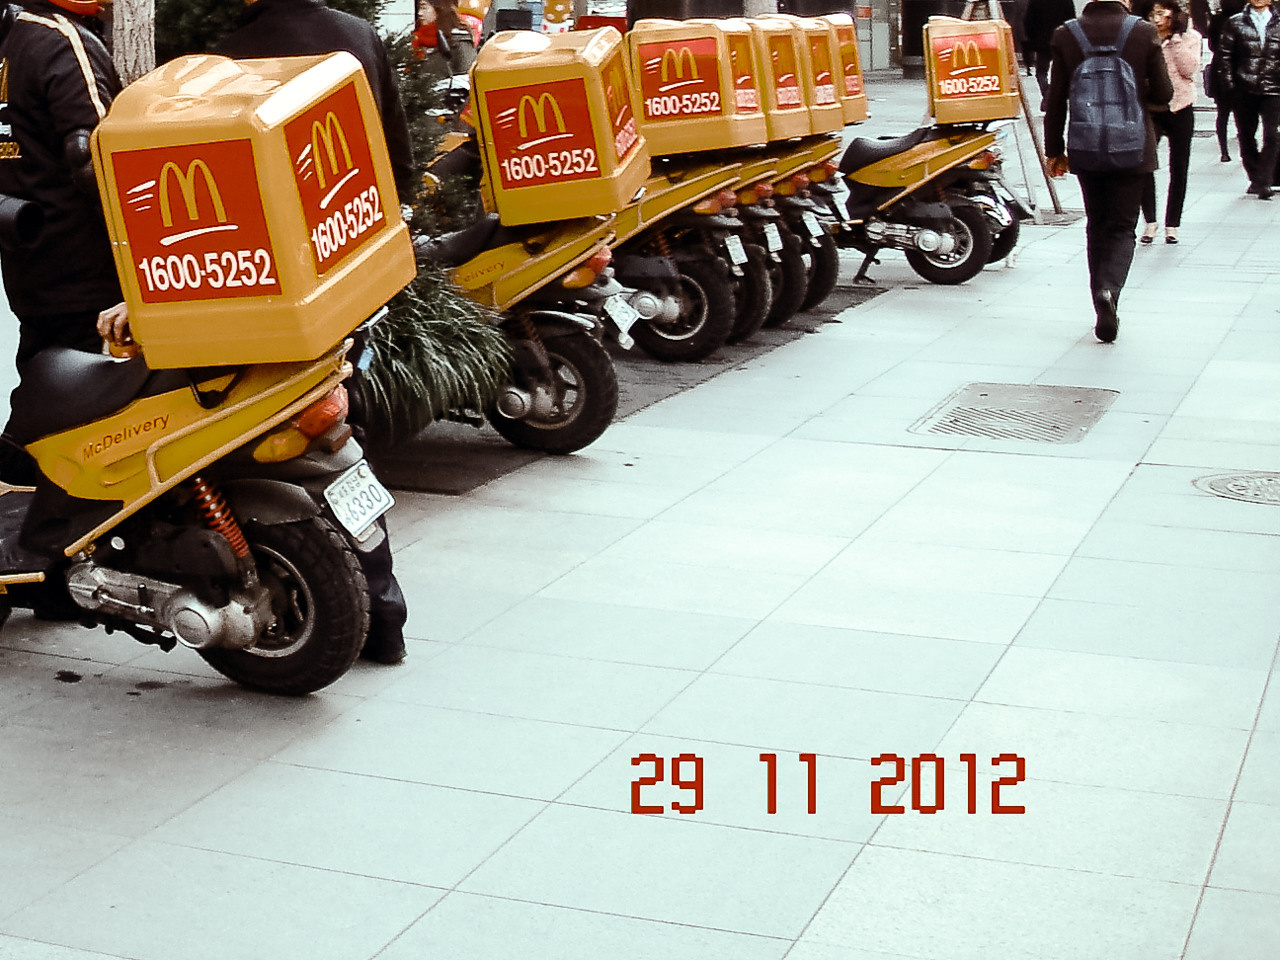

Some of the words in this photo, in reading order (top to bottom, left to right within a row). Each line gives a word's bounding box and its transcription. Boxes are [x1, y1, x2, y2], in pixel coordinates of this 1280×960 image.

[645, 91, 721, 117] 1600-5252
[938, 75, 1001, 95] 1600-5252
[501, 147, 599, 182] 1600-5252
[311, 185, 384, 263] 1600-5252
[139, 248, 276, 291] 1600-5252
[82, 414, 170, 461] McDelivery
